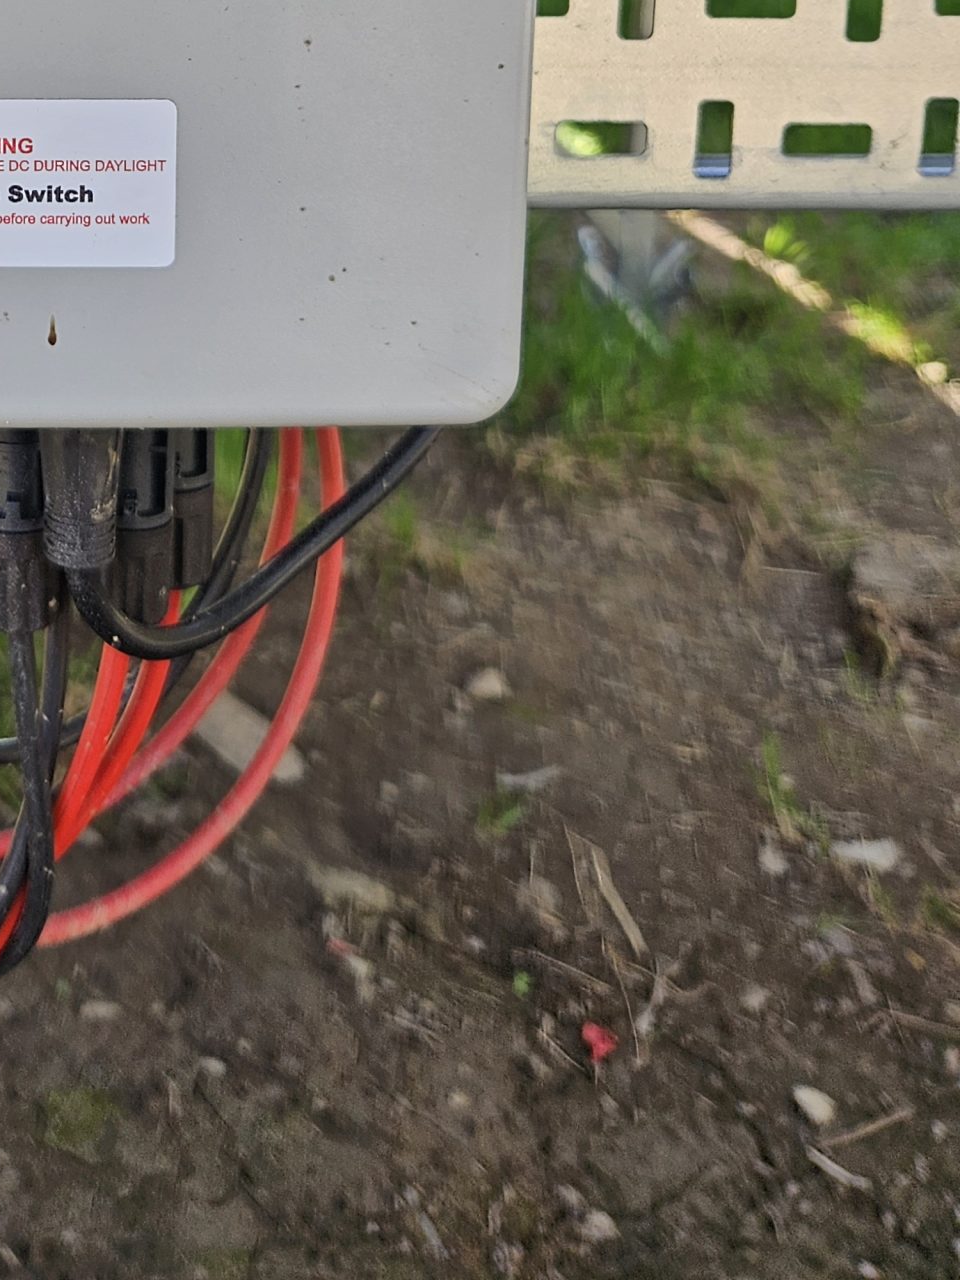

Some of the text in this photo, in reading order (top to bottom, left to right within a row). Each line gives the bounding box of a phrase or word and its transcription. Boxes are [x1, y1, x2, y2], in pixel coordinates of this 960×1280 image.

[8, 159, 30, 173] DC
[33, 159, 91, 173] DURING
[95, 159, 167, 173] DAYLIGHT
[7, 184, 94, 204] Switch
[39, 212, 91, 228] carrying
[94, 213, 116, 225] out
[118, 212, 150, 225] work
